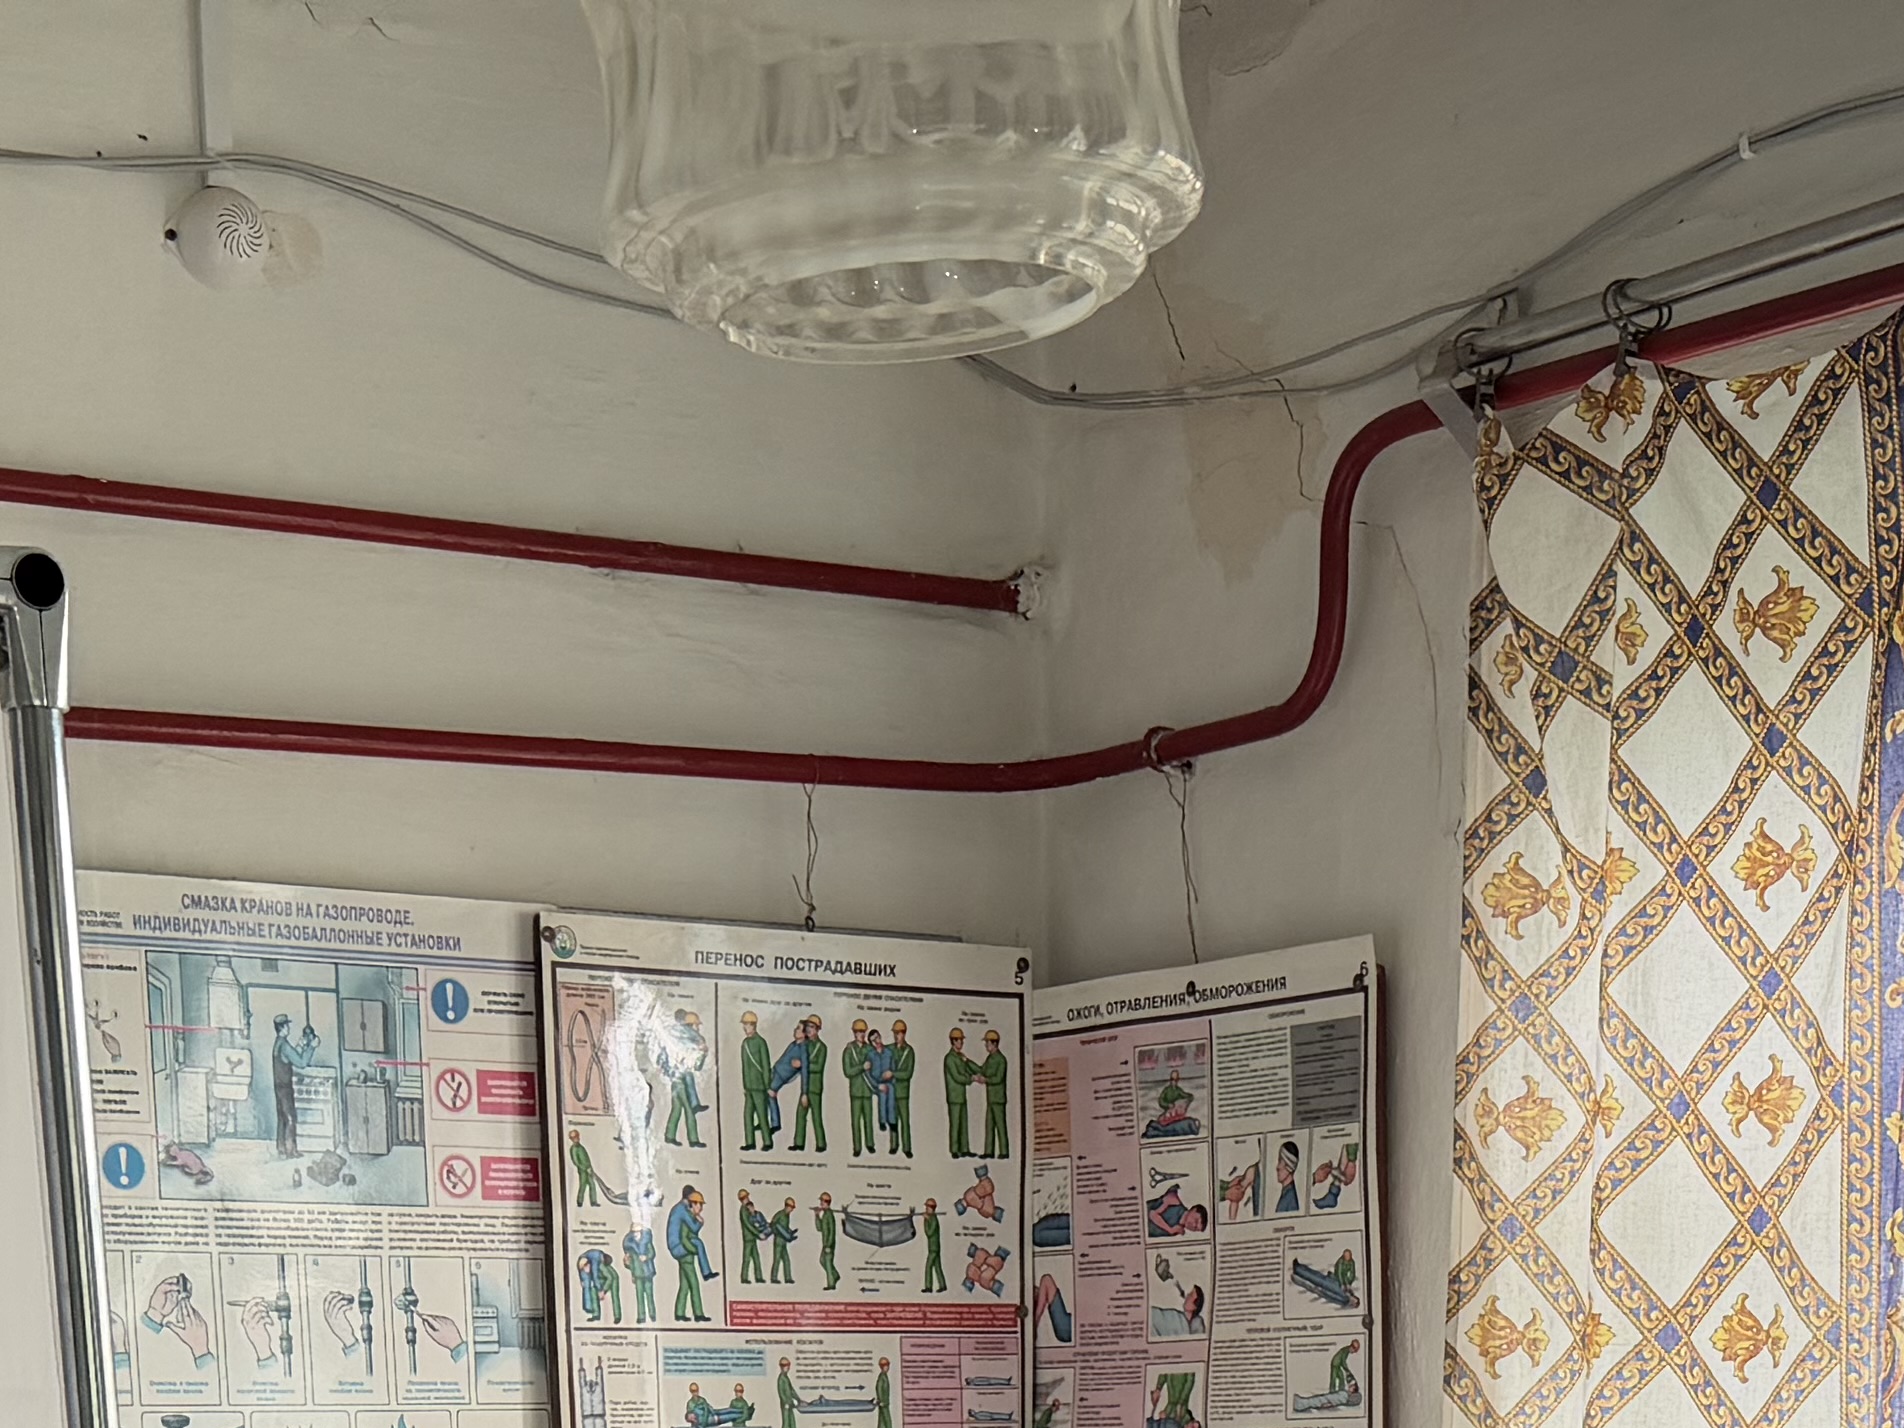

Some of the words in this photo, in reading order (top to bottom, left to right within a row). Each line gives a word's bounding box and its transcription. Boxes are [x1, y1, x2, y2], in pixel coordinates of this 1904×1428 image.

[181, 893, 237, 917] СМАЗКА
[240, 897, 293, 920] КРАНОВ
[296, 901, 313, 921] НА
[316, 902, 415, 927] ГАЗОПРОВОДЕ.
[133, 914, 265, 941] ИНДИВИДУАЛЬНЫЕ
[267, 922, 383, 947] ГАЗОБАЛЛОННЫЕ
[386, 931, 462, 952] УСТАНОВКИ
[695, 950, 764, 970] ПЕРЕНОС
[773, 954, 897, 978] ПОСТРАДАВШИХ
[1013, 969, 1024, 985] 5
[1067, 1003, 1104, 1022] ОЖОГИ,
[1105, 990, 1190, 1016] ОТРАВЛЕНИЯ,
[1192, 975, 1287, 1004] ОБМОРОЖЕНИЯ
